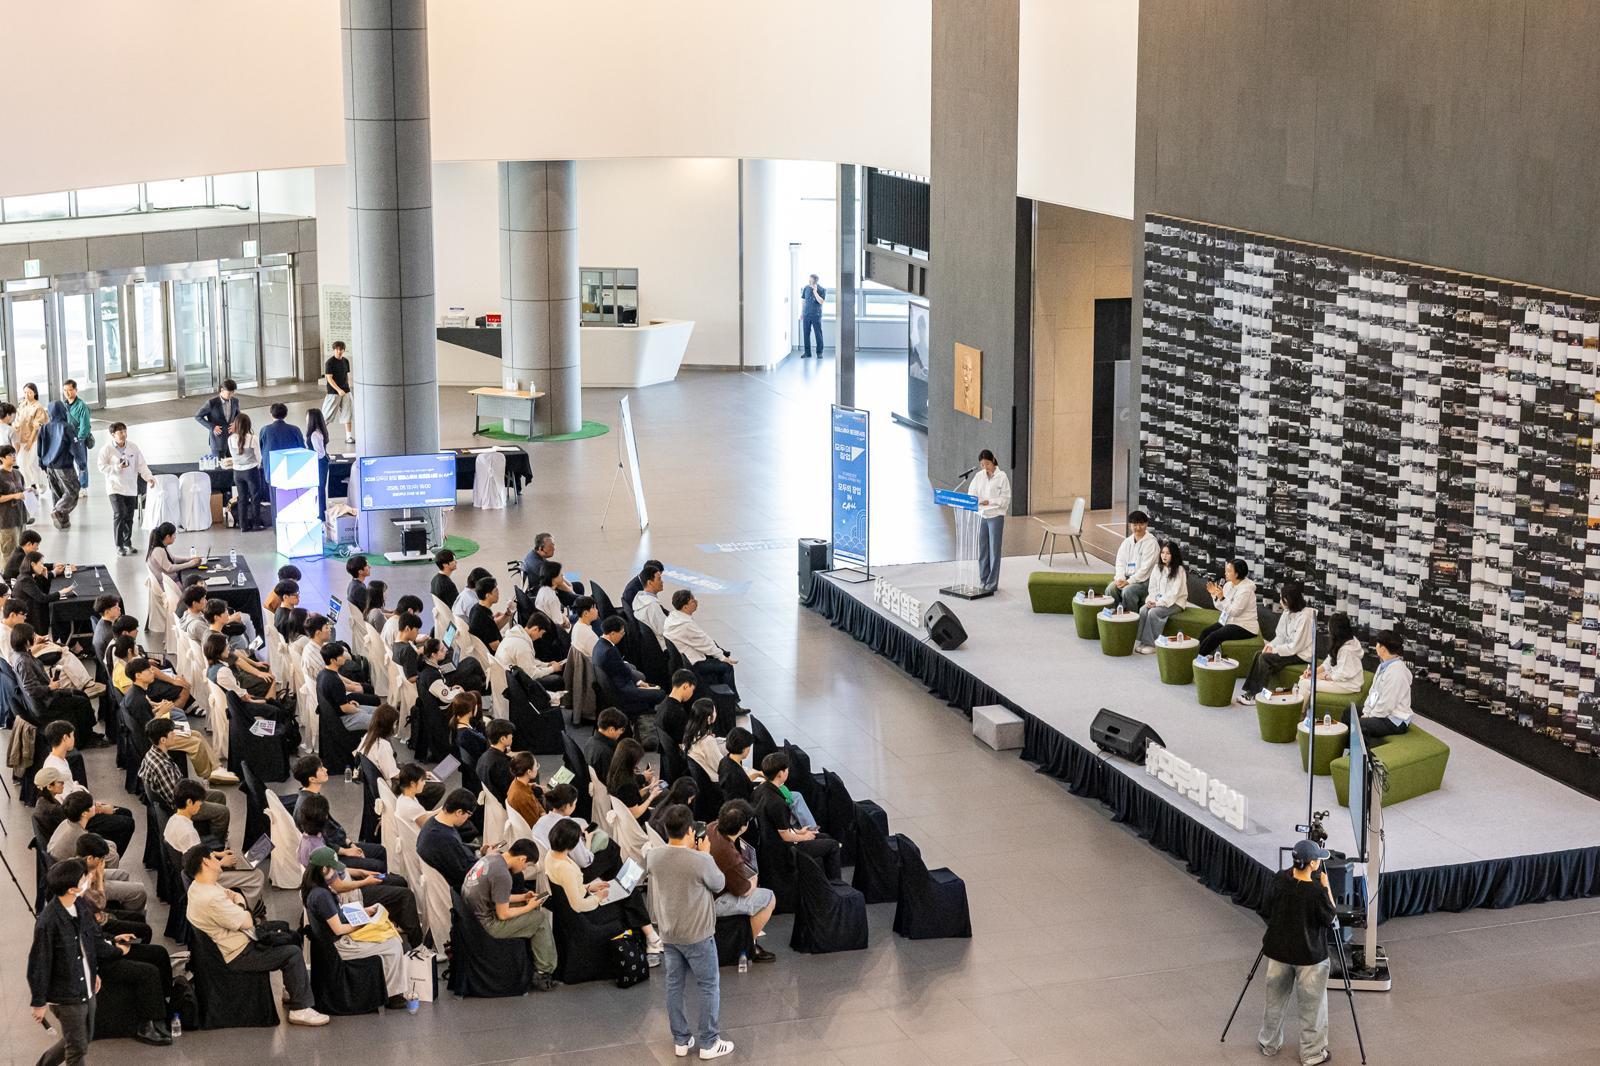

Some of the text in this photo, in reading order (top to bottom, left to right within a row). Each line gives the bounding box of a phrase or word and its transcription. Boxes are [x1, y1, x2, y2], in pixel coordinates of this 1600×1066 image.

[835, 443, 850, 453] 모두의
[838, 483, 861, 496] 모두의 창업
[1208, 778, 1245, 831] 창업
